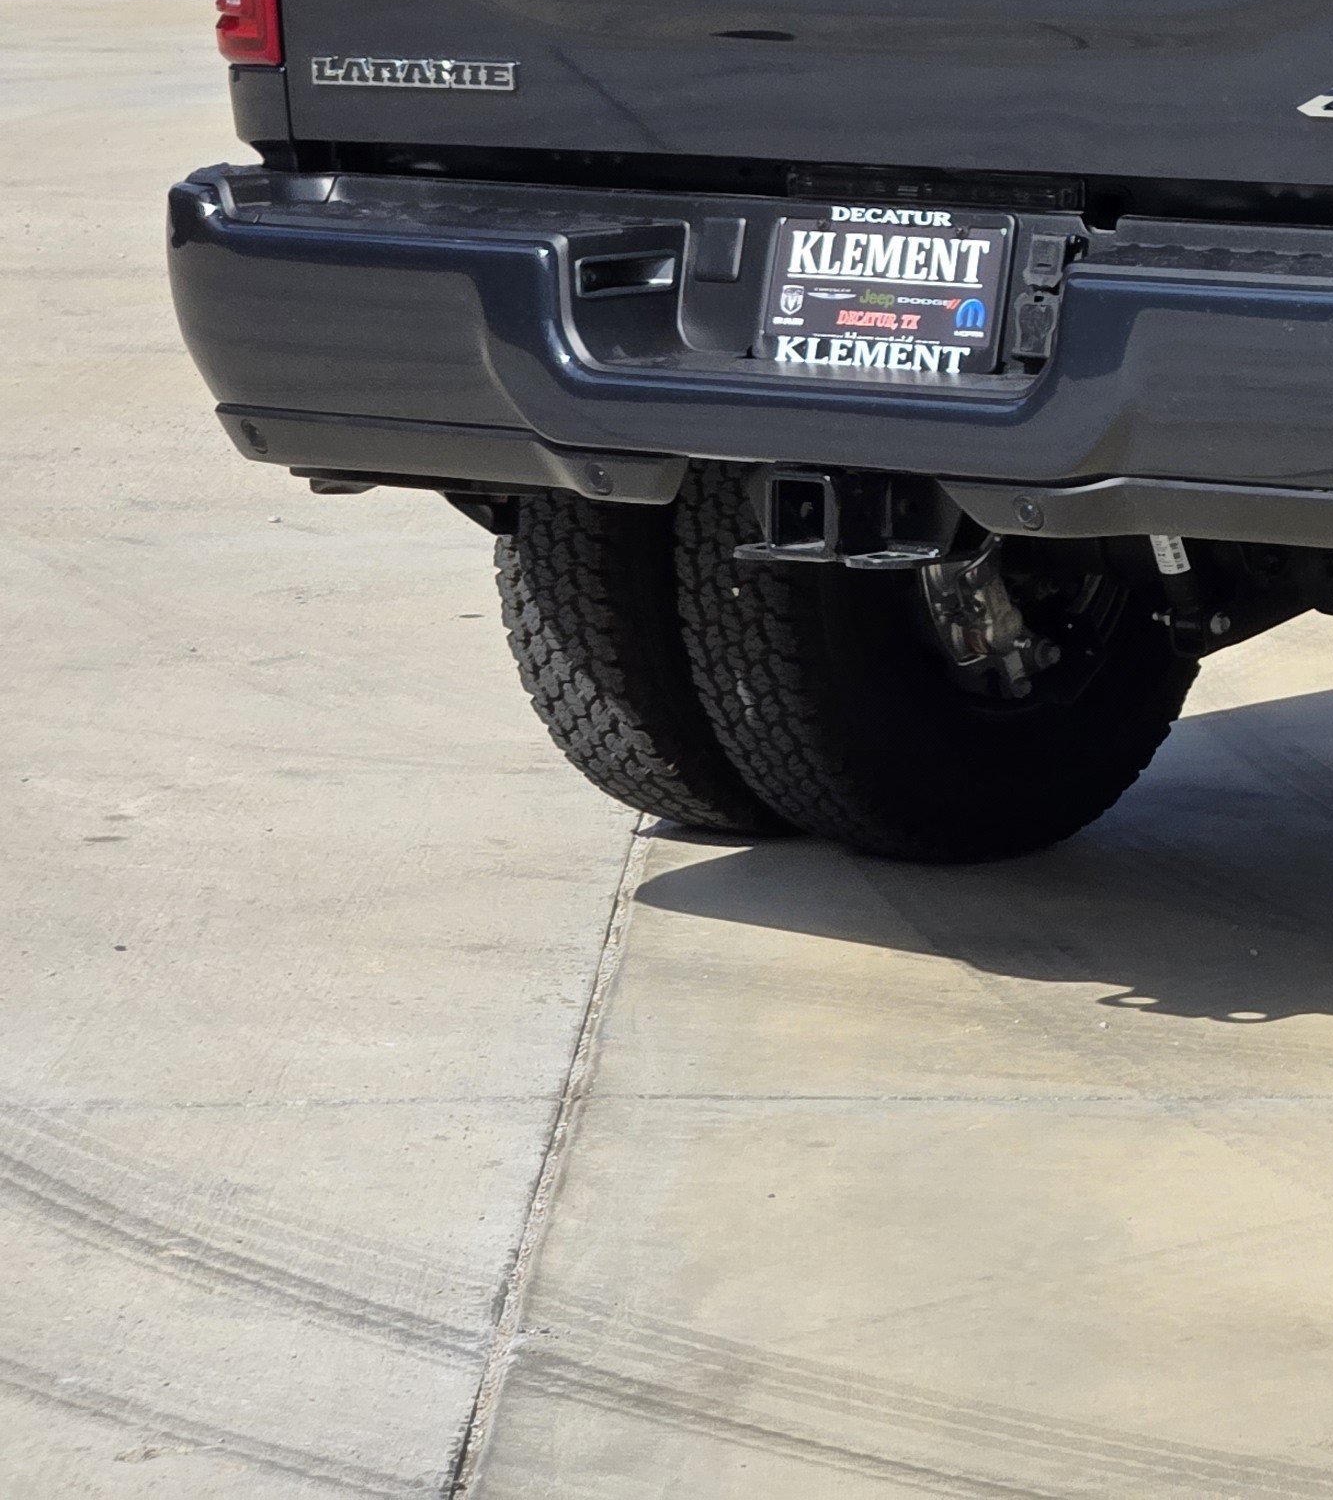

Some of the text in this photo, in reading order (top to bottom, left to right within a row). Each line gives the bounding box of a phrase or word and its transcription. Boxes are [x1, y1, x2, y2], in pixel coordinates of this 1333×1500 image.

[311, 56, 520, 91] LARAMIE
[831, 205, 952, 227] DECATUR
[787, 230, 991, 283] KLEMENT
[859, 288, 895, 308] Jeep
[775, 335, 971, 374] KLEMENT
